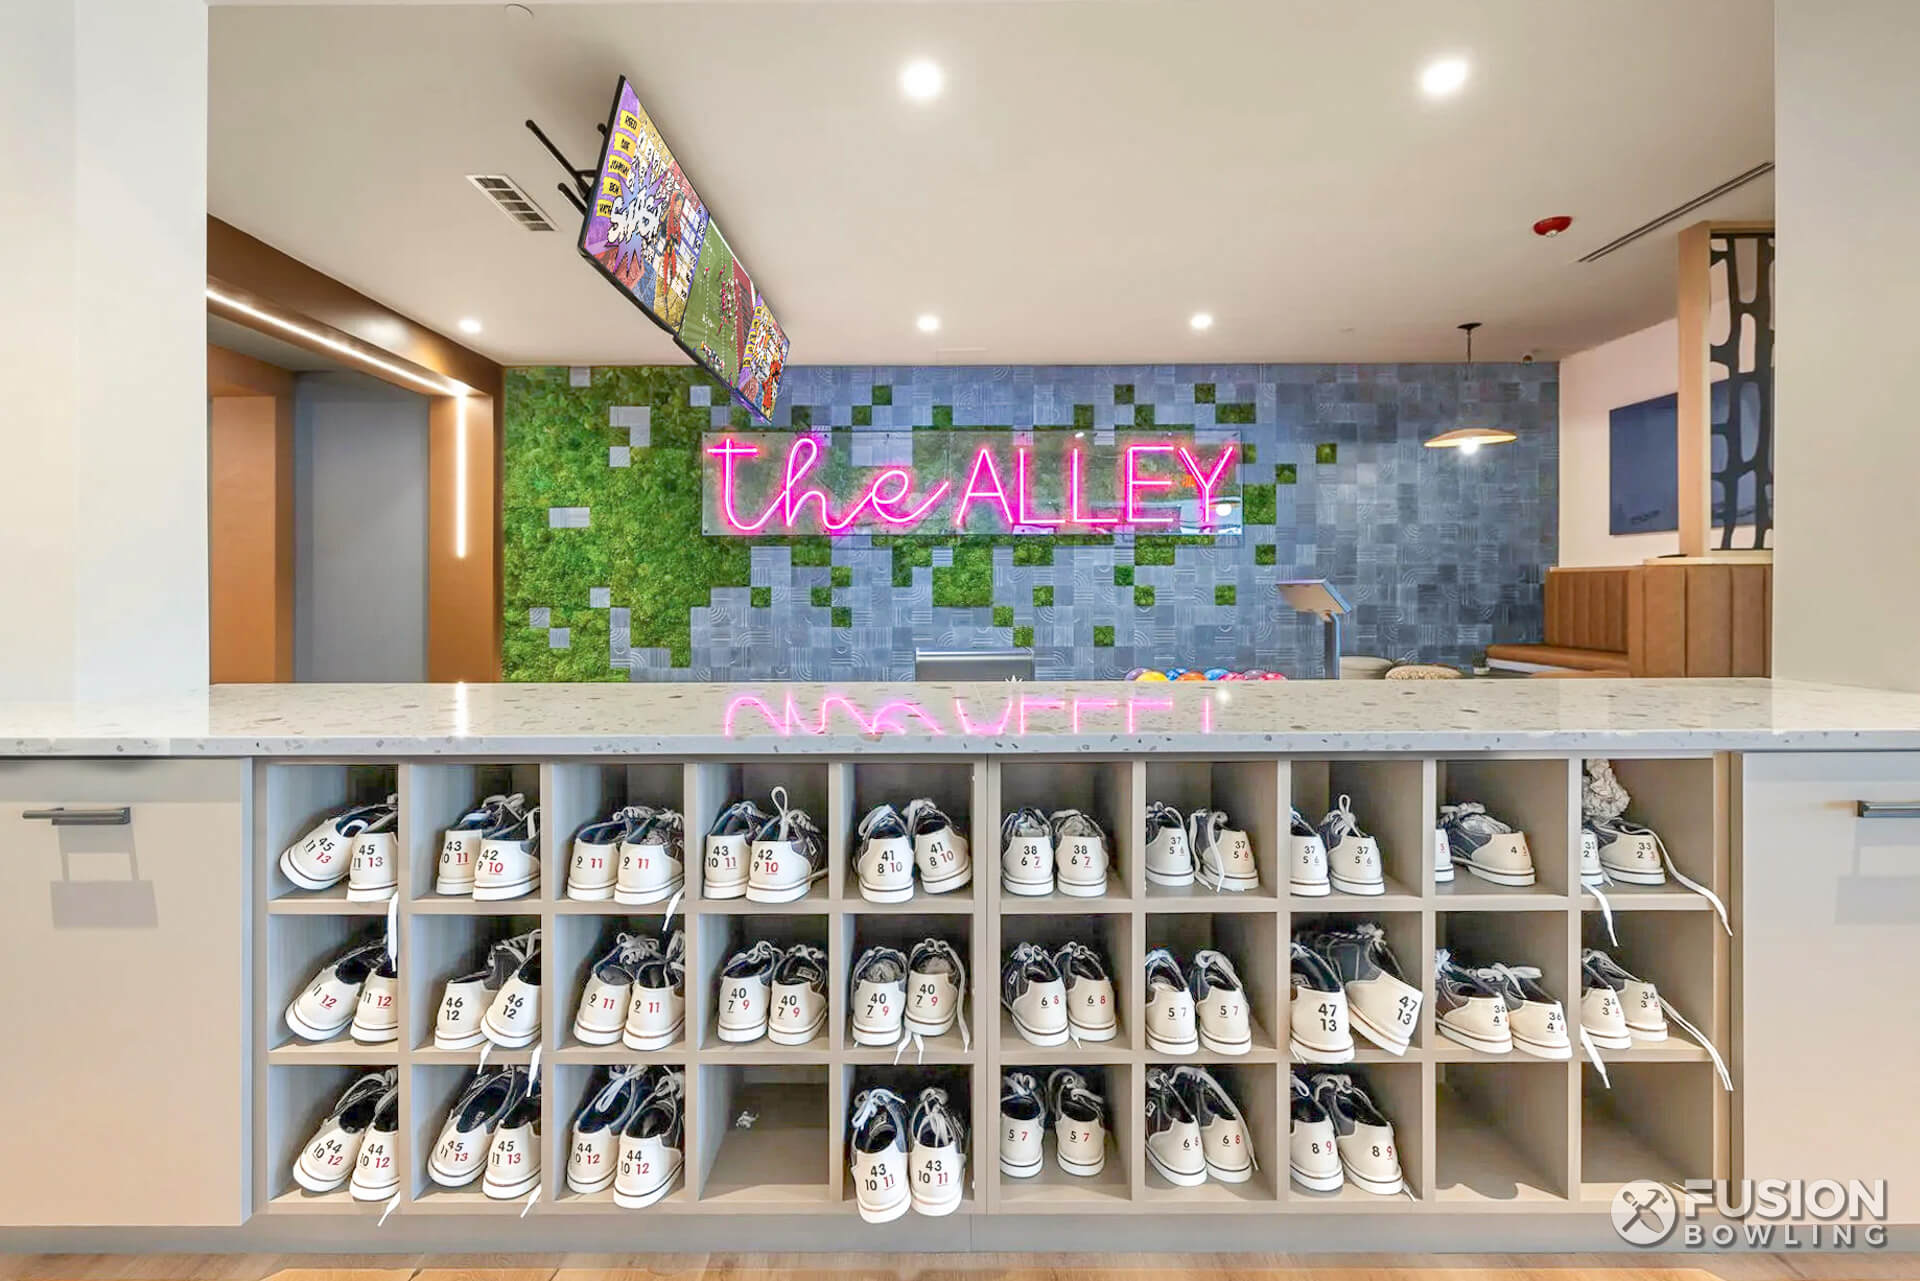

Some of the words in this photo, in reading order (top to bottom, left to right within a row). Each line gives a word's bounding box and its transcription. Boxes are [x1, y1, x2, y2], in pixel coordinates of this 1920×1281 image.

[707, 437, 949, 531] the
[956, 446, 1234, 525] ALLEY
[320, 837, 335, 852] 45
[447, 841, 462, 851] 43
[1170, 837, 1181, 845] 37
[1235, 841, 1246, 849] 37
[306, 840, 316, 853] 11
[316, 852, 332, 864] 13
[359, 844, 375, 855] 45
[713, 846, 729, 857] 43
[930, 842, 944, 854] 41
[1024, 845, 1037, 855] 38
[1074, 845, 1087, 855] 38
[1304, 846, 1315, 854] 37
[1357, 847, 1368, 855] 37
[1511, 846, 1517, 854] 4
[456, 853, 468, 863] 11
[482, 849, 499, 860] 42
[758, 849, 773, 861] 42
[881, 851, 894, 862] 41
[930, 856, 937, 866] 8
[941, 851, 954, 862] 10
[1303, 856, 1309, 864] 5
[1355, 856, 1361, 864] 5
[354, 858, 361, 868] 11
[368, 857, 383, 868] 13
[577, 857, 583, 866] 9
[591, 858, 602, 869] 11
[623, 857, 630, 867] 9
[638, 859, 649, 869] 11
[708, 857, 718, 868] 10
[726, 857, 737, 867] 11
[1021, 856, 1028, 866] 6
[1034, 856, 1040, 866] 7
[1071, 855, 1078, 865] 6
[1084, 856, 1091, 866] 7
[489, 862, 504, 873] 10
[753, 861, 759, 872] 9
[765, 862, 778, 873] 10
[877, 863, 884, 874] 8
[890, 862, 903, 873] 10
[731, 988, 747, 998] 40
[920, 984, 935, 995] 40
[321, 994, 337, 1008] 12
[378, 996, 392, 1006] 12
[446, 997, 462, 1008] 46
[508, 994, 523, 1008] 46
[590, 994, 597, 1004] 9
[603, 998, 614, 1010] 11
[781, 995, 797, 1006] 40
[871, 993, 887, 1004] 40
[916, 995, 923, 1005] 7
[931, 996, 938, 1006] 9
[1041, 997, 1048, 1007] 6
[1088, 995, 1094, 1005] 6
[1100, 995, 1106, 1005] 8
[1399, 996, 1417, 1012] 47
[635, 1001, 641, 1012] 9
[649, 1002, 660, 1012] 11
[728, 1000, 735, 1011] 7
[743, 1000, 750, 1010] 9
[867, 1005, 874, 1016] 7
[882, 1006, 889, 1016] 9
[1220, 1005, 1227, 1015] 5
[1233, 1006, 1239, 1015] 7
[1318, 1004, 1337, 1017] 47
[446, 1010, 460, 1021] 12
[503, 1005, 516, 1019] 12
[778, 1007, 784, 1018] 7
[793, 1007, 800, 1018] 9
[1168, 1008, 1174, 1018] 5
[1181, 1008, 1187, 1017] 7
[1397, 1008, 1412, 1025] 13
[1549, 1012, 1562, 1021] 36
[1320, 1019, 1337, 1032] 13
[1009, 1129, 1015, 1139] 5
[1021, 1131, 1028, 1141] 7
[1070, 1131, 1076, 1140] 5
[1083, 1132, 1090, 1142] 7
[1223, 1135, 1229, 1145] 6
[1235, 1135, 1241, 1144] 8
[326, 1140, 342, 1154] 44
[448, 1141, 464, 1152] 45
[498, 1141, 514, 1152] 45
[577, 1143, 592, 1153] 44
[1184, 1138, 1190, 1148] 6
[1312, 1143, 1320, 1154] 8
[1326, 1141, 1332, 1152] 9
[314, 1143, 325, 1159] 10
[328, 1155, 343, 1166] 12
[368, 1144, 383, 1156] 44
[627, 1150, 642, 1161] 44
[1372, 1146, 1380, 1157] 8
[1387, 1146, 1392, 1157] 9
[455, 1152, 468, 1161] 13
[492, 1152, 500, 1165] 11
[508, 1153, 521, 1164] 13
[587, 1154, 600, 1164] 12
[376, 1157, 390, 1168] 12
[925, 1160, 942, 1171] 43
[637, 1163, 649, 1175] 12
[870, 1163, 886, 1177] 43
[865, 1179, 877, 1191] 10
[884, 1175, 895, 1188] 11
[918, 1171, 930, 1184] 10
[938, 1172, 948, 1184] 11
